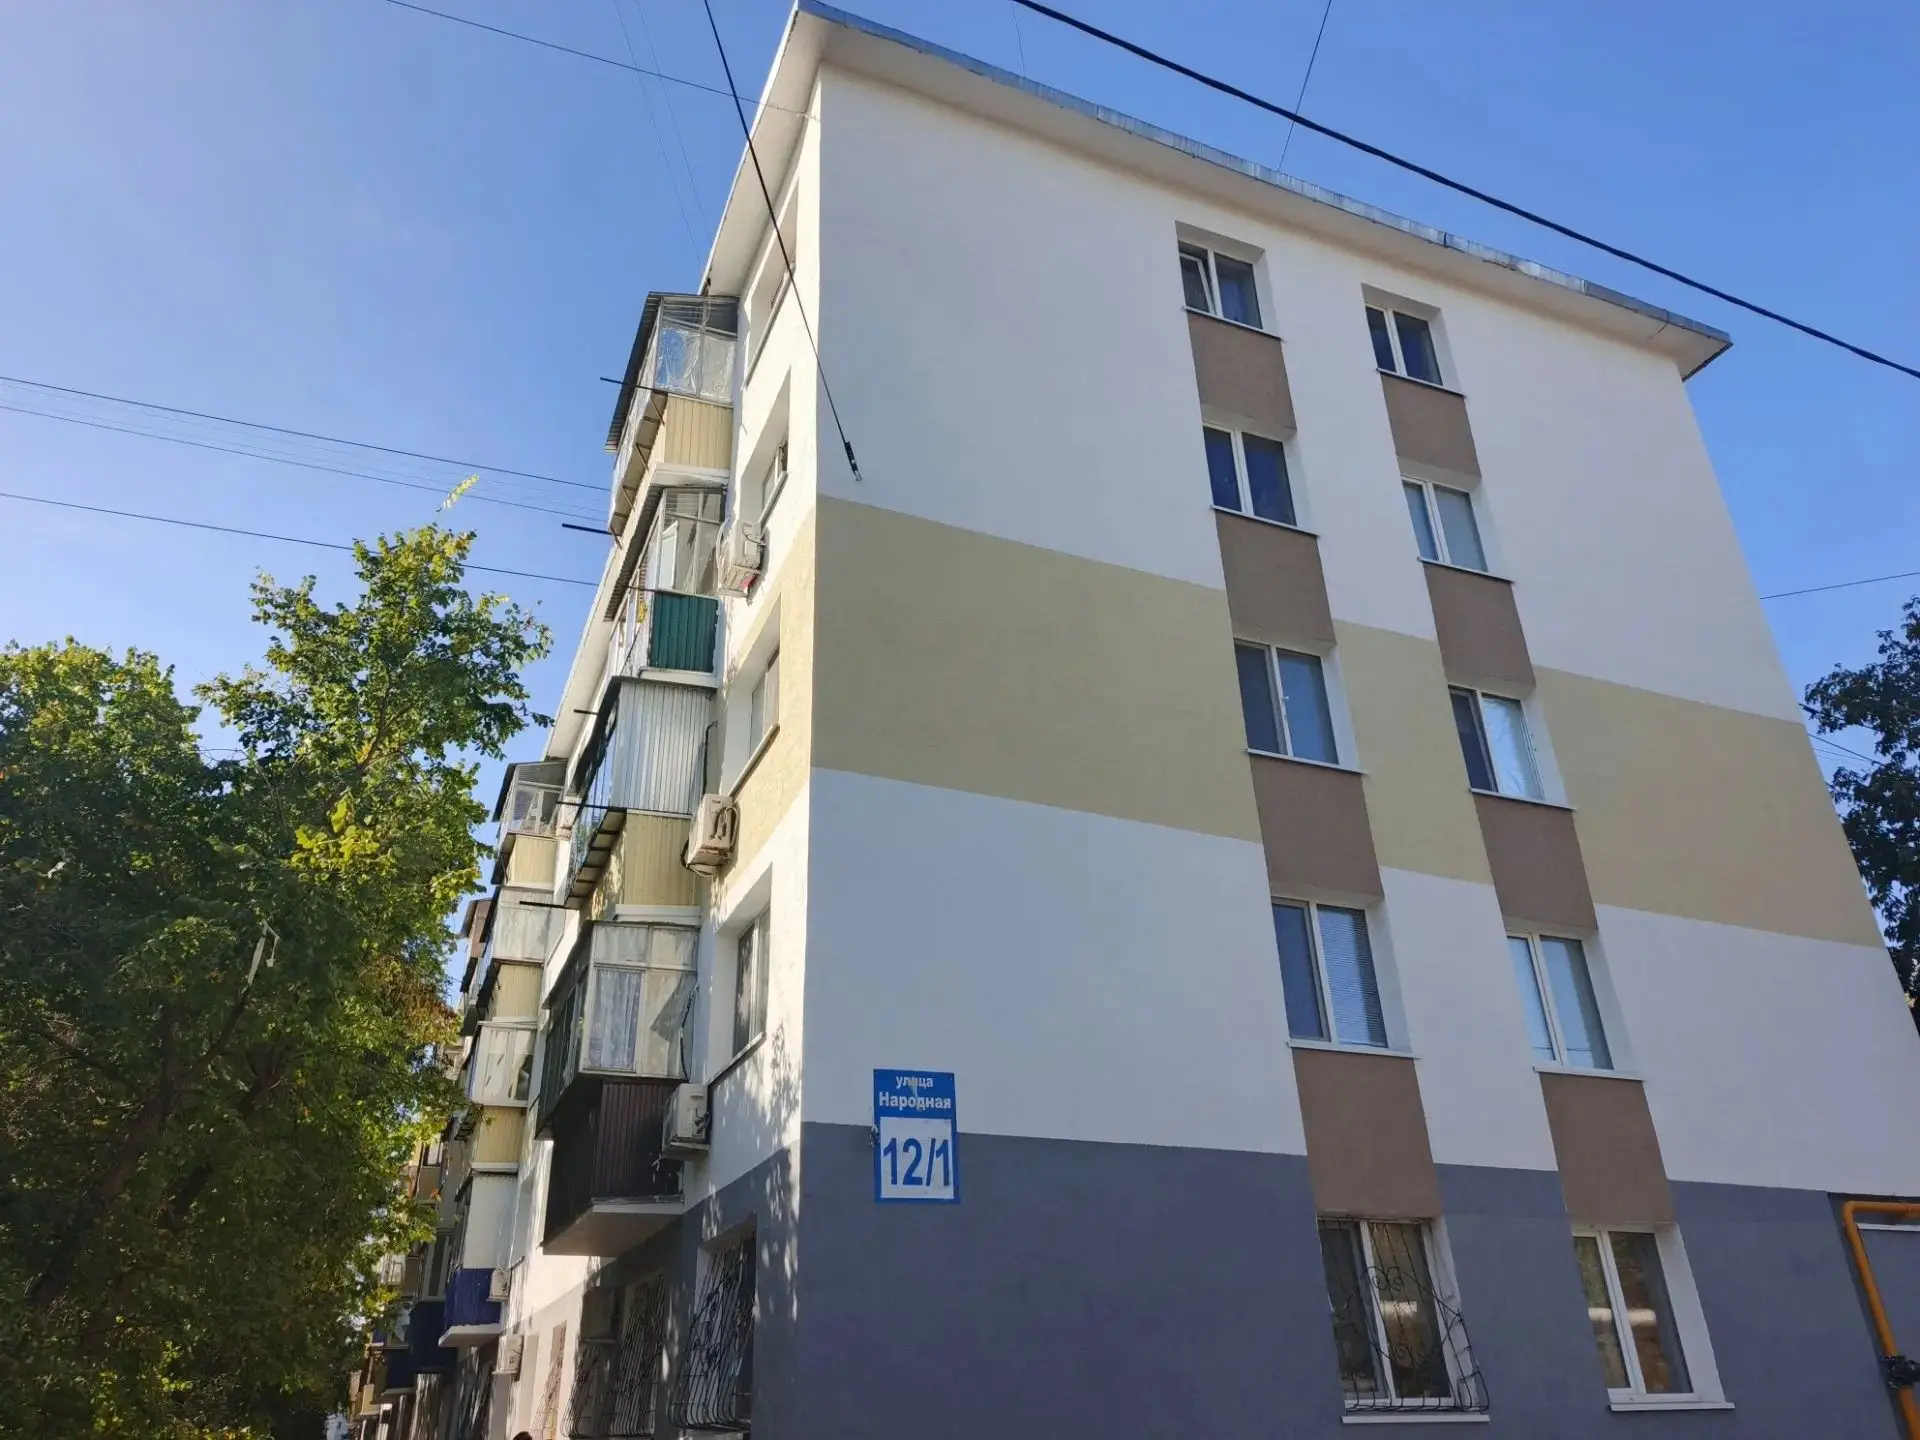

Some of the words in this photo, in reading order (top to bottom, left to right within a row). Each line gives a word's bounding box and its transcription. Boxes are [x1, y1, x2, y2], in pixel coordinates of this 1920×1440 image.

[895, 1075, 934, 1089] улица
[879, 1091, 952, 1111] Народная
[882, 1137, 950, 1187] 12/1
